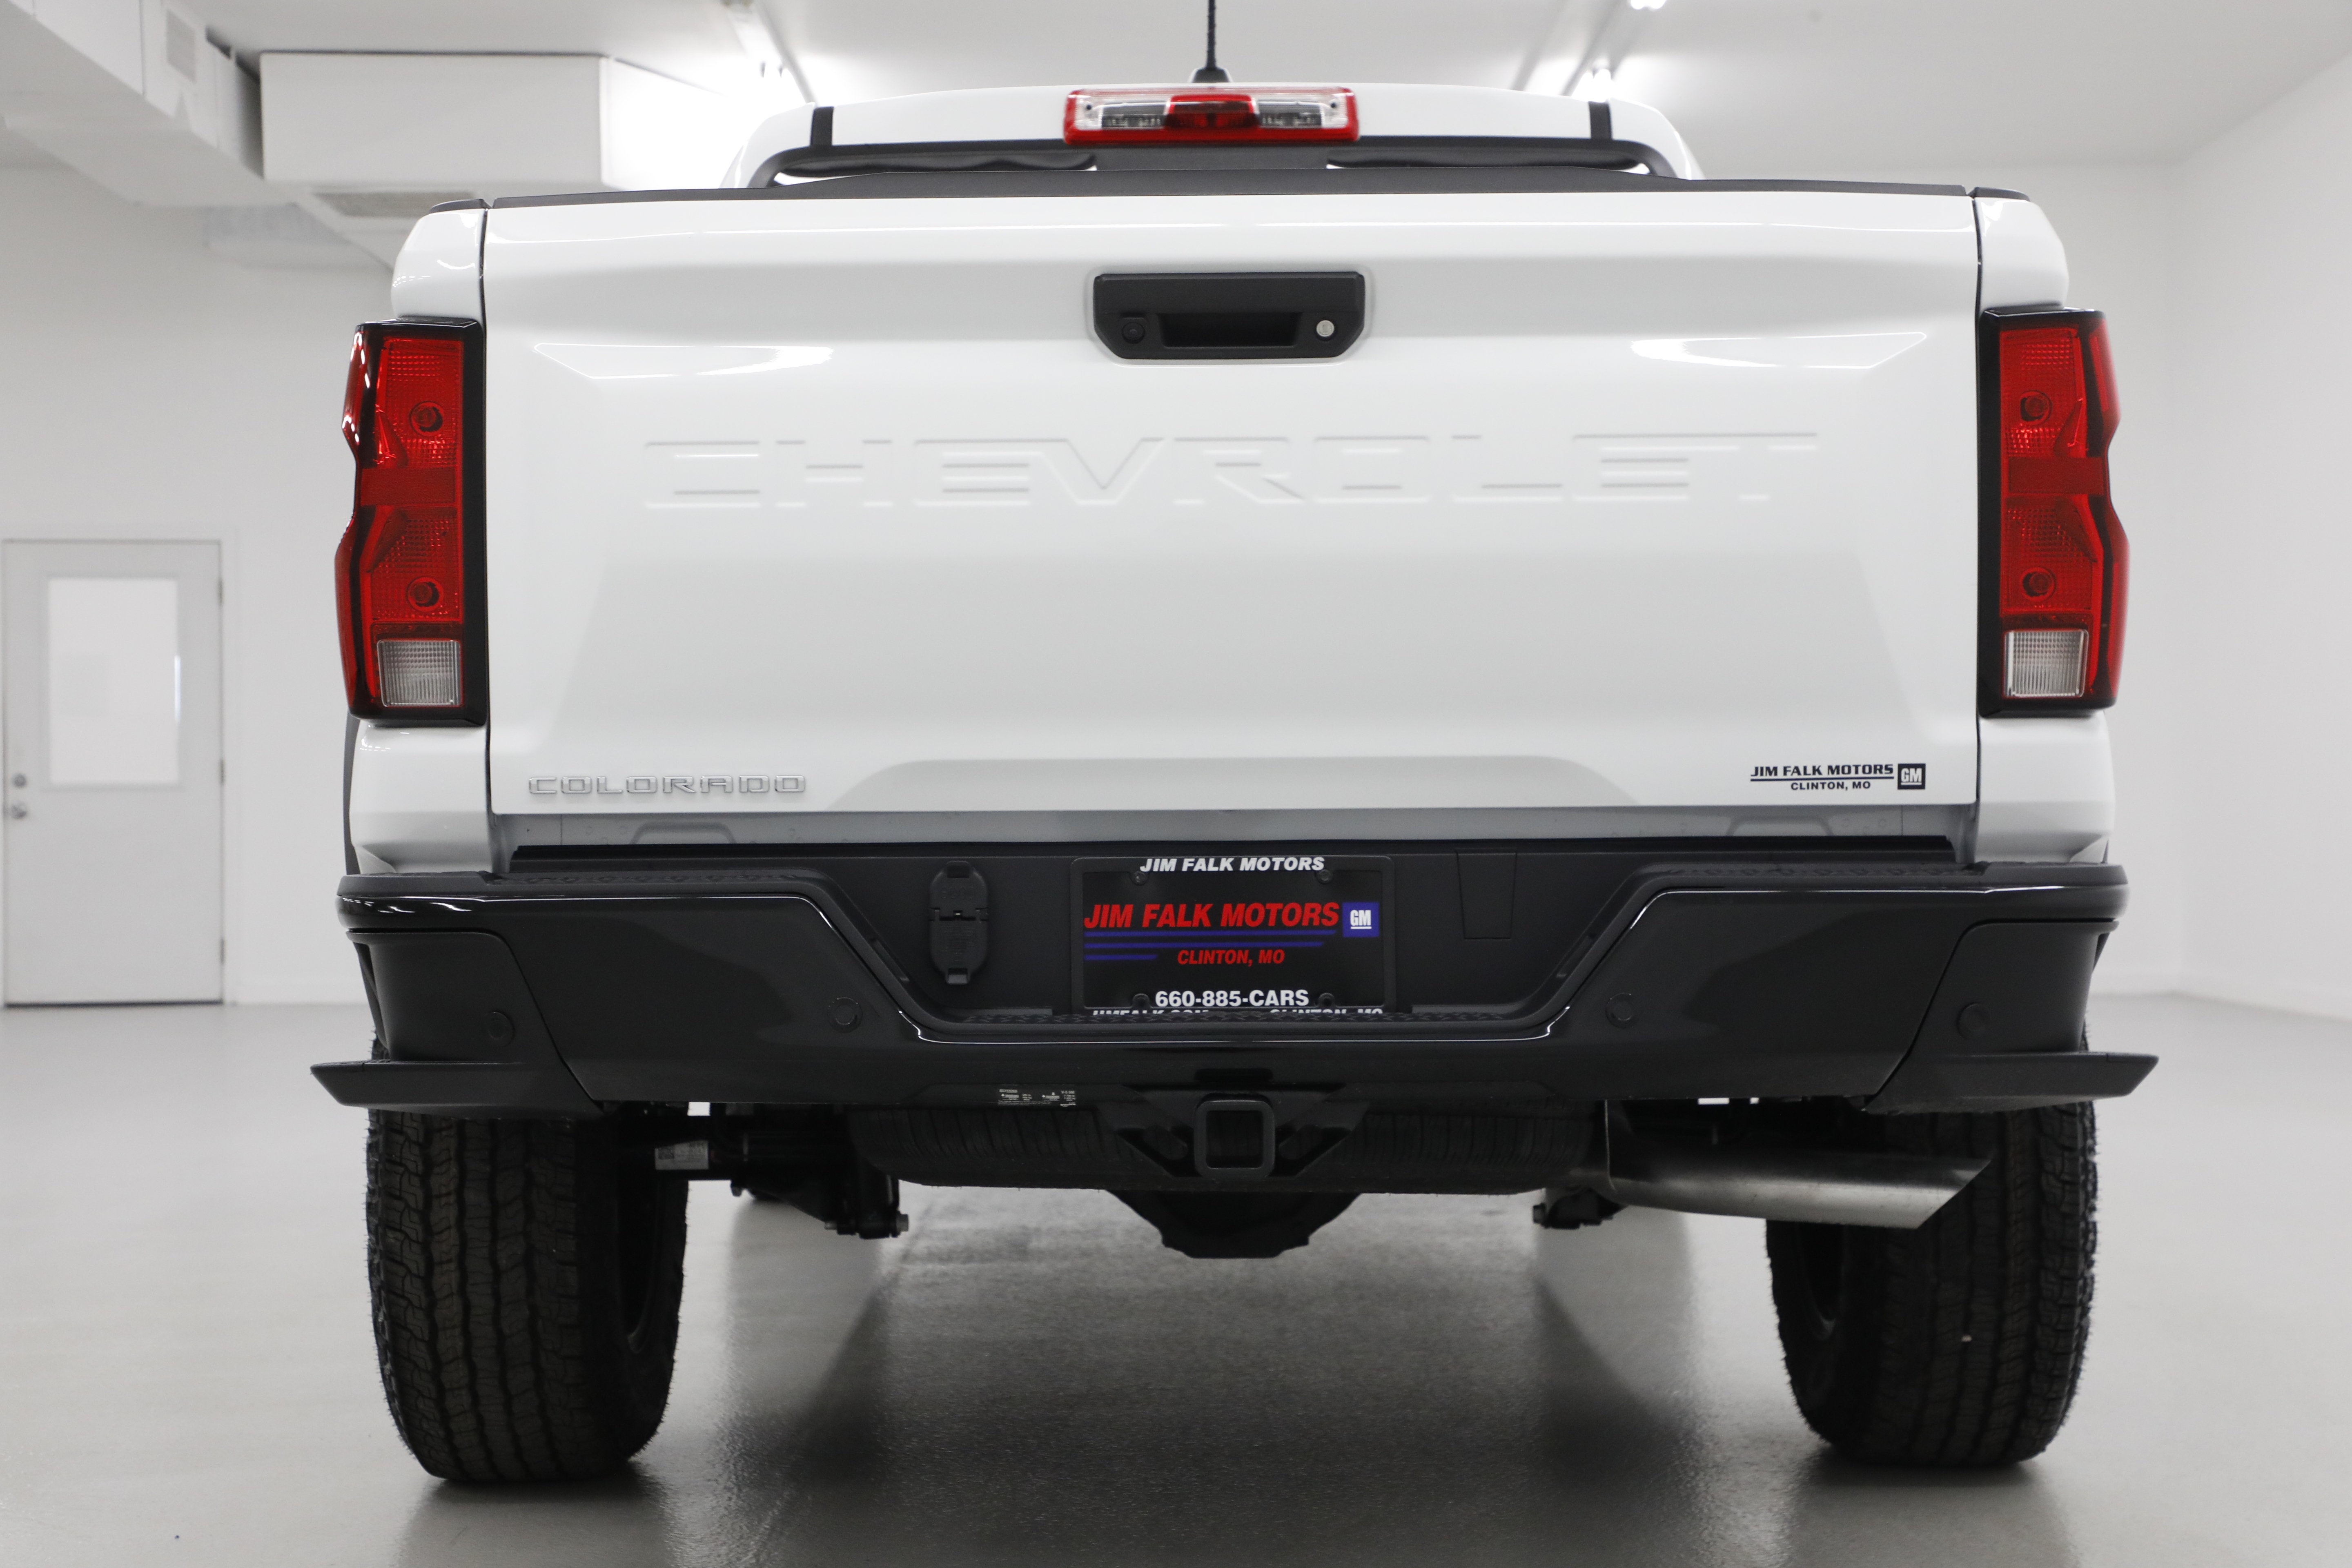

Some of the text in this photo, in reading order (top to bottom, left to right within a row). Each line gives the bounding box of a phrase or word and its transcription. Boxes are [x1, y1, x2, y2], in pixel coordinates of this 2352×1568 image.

[644, 433, 1817, 508] CHEVROLET
[1751, 764, 1893, 777] JIM FALK MOTORS
[1901, 768, 1922, 783] GM
[529, 776, 806, 794] COLORADO
[1791, 781, 1871, 791] CLINTON, MO
[1140, 857, 1325, 872] JIM FALK MOTORS
[1084, 902, 1339, 929] JIM FALK MOTORS
[1350, 909, 1372, 927] GM
[1177, 949, 1285, 967] CLINTON, MO
[1155, 990, 1309, 1007] 660-885-CARS
